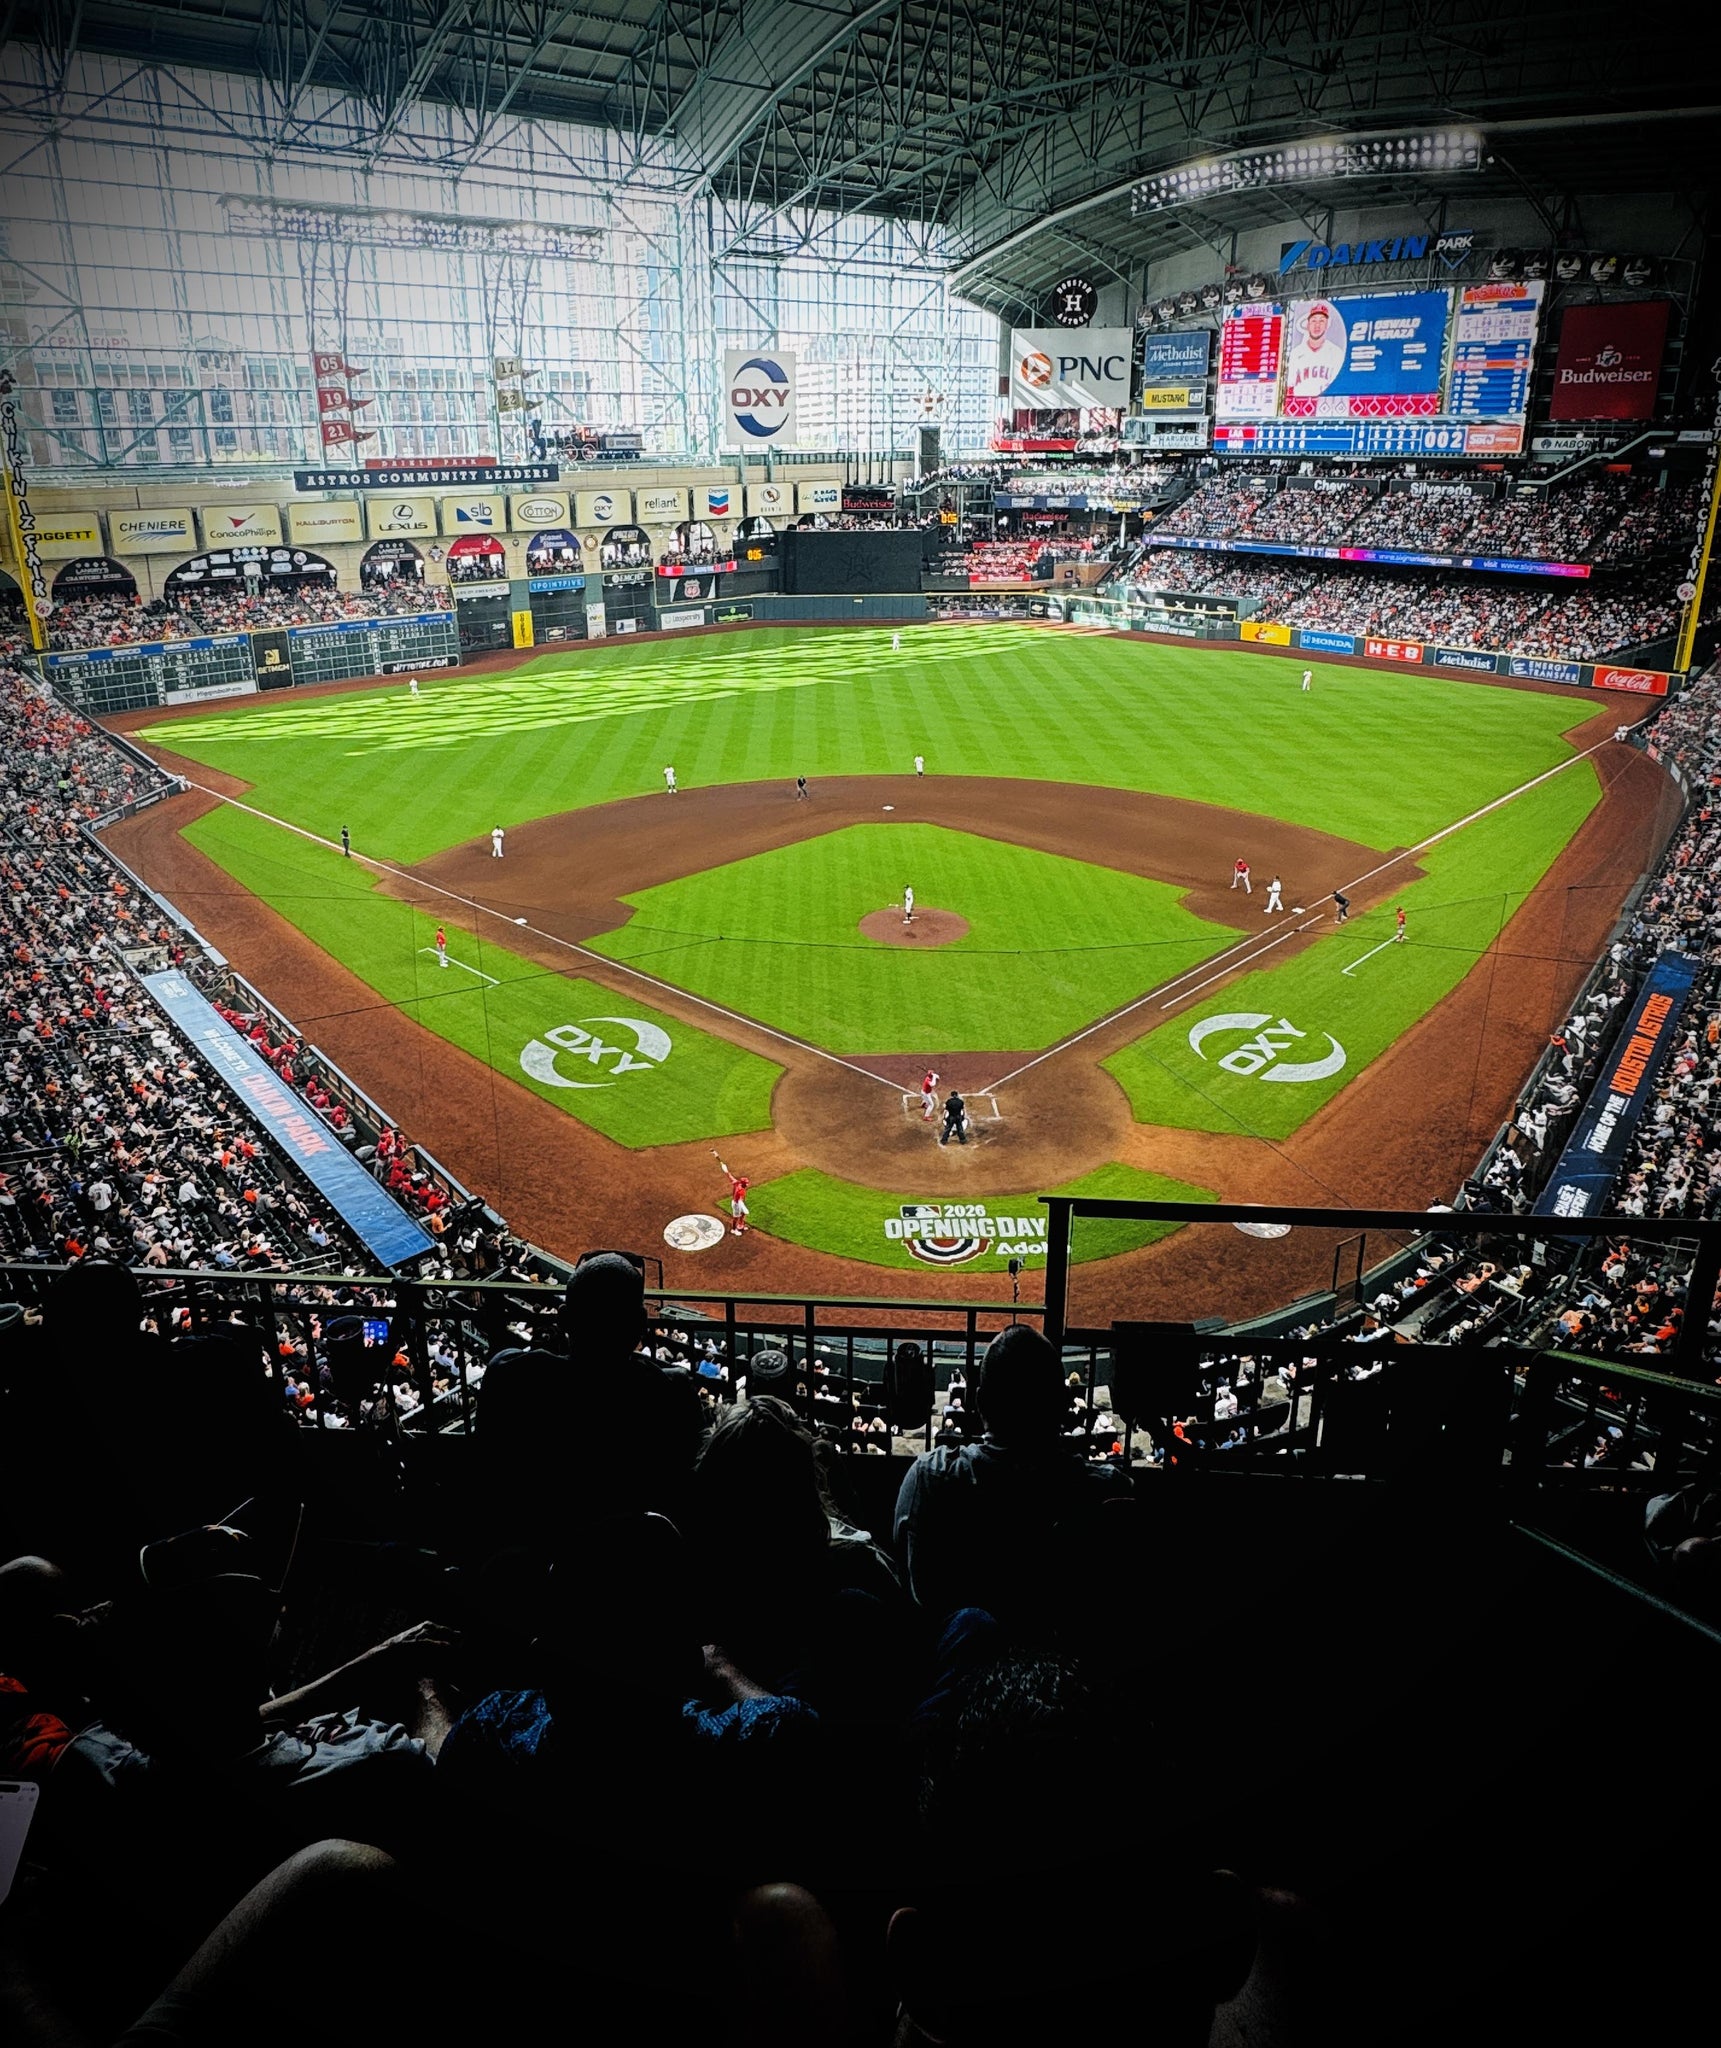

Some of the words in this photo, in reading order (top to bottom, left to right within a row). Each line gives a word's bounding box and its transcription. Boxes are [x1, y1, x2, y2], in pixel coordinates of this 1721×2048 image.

[1436, 235, 1474, 251] PARK
[1306, 235, 1430, 269] DAIKIN
[1057, 279, 1093, 295] HOUSTON
[1065, 294, 1082, 312] H
[1349, 321, 1368, 342] 2
[1150, 347, 1204, 363] Methodist
[319, 357, 338, 371] 05
[500, 361, 515, 374] 17
[1056, 355, 1125, 381] PNC
[1559, 367, 1652, 385] Budweiser
[324, 392, 342, 406] 19
[502, 394, 516, 407] 22
[731, 388, 791, 408] OXY
[1151, 394, 1185, 404] MUSTANG
[327, 425, 345, 439] 21
[1, 402, 28, 498] CHIKIN
[1553, 439, 1594, 449] NABOR
[381, 459, 433, 467] DAIKIN
[444, 458, 477, 466] PARK
[307, 473, 371, 486] ASTROS
[378, 470, 478, 484] COMMUNITY
[484, 468, 550, 481] LEADERS
[470, 502, 492, 517] slb
[593, 504, 613, 512] OXY
[644, 497, 678, 510] reliant
[843, 498, 895, 510] Budweiser
[19, 500, 36, 531] IZ
[119, 519, 187, 533] CHENIERE
[379, 522, 428, 532] LEXUS
[1686, 508, 1709, 581] CHIKIN
[22, 533, 47, 598] FAIR
[1135, 595, 1229, 613] LEXUS
[1311, 638, 1353, 649] HONDA
[1439, 654, 1492, 671] Methodist
[1528, 660, 1570, 672] ENERGY
[1528, 669, 1577, 682] TRANSFER
[544, 1024, 655, 1075] OXY
[1217, 1017, 1308, 1076] OXY
[1608, 1034, 1656, 1096] HOUSTON
[1635, 992, 1674, 1040] ASTROS
[1599, 1110, 1618, 1127] OF
[277, 1115, 333, 1158] PARK
[1587, 1122, 1614, 1154] HOME
[943, 1204, 986, 1218] 2026
[884, 1216, 997, 1239] OPENING
[995, 1216, 1047, 1238] DAY
